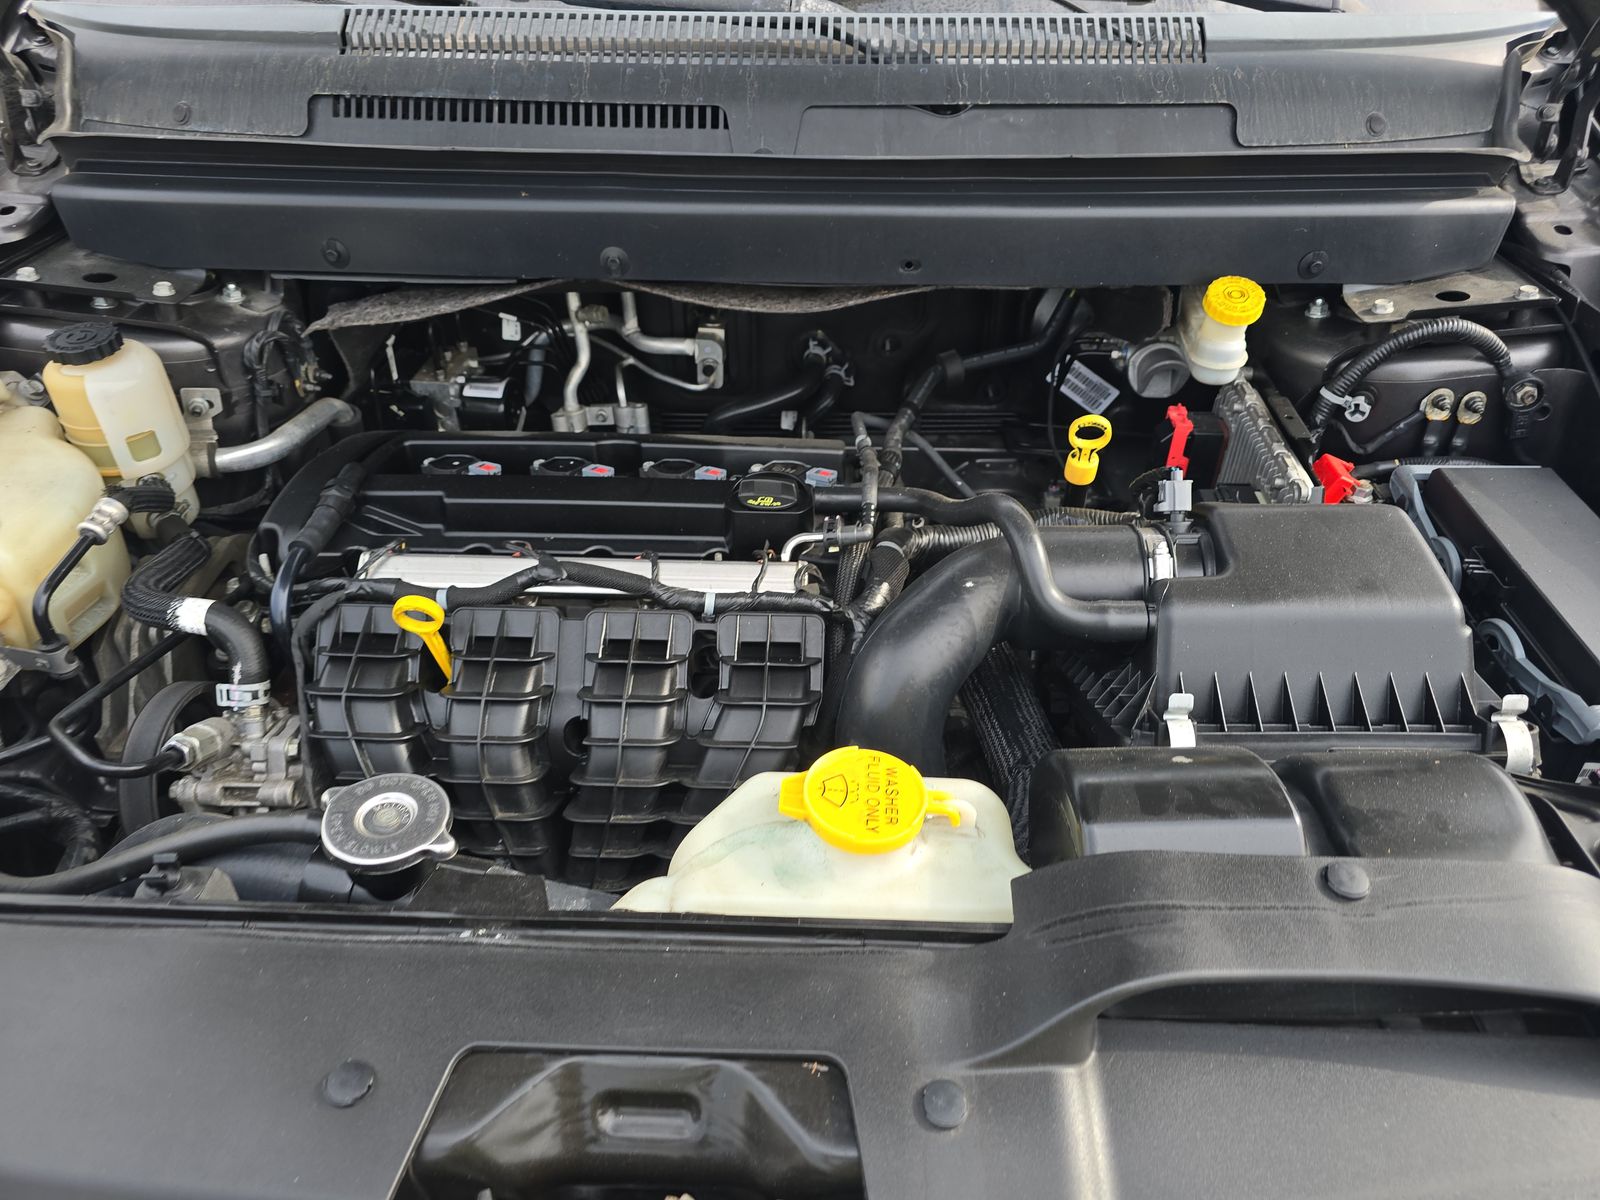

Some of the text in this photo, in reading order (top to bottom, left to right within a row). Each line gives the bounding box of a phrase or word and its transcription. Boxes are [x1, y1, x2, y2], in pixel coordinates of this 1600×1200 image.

[865, 755, 880, 834] FLUID ONLY
[885, 767, 899, 826] WASHER
